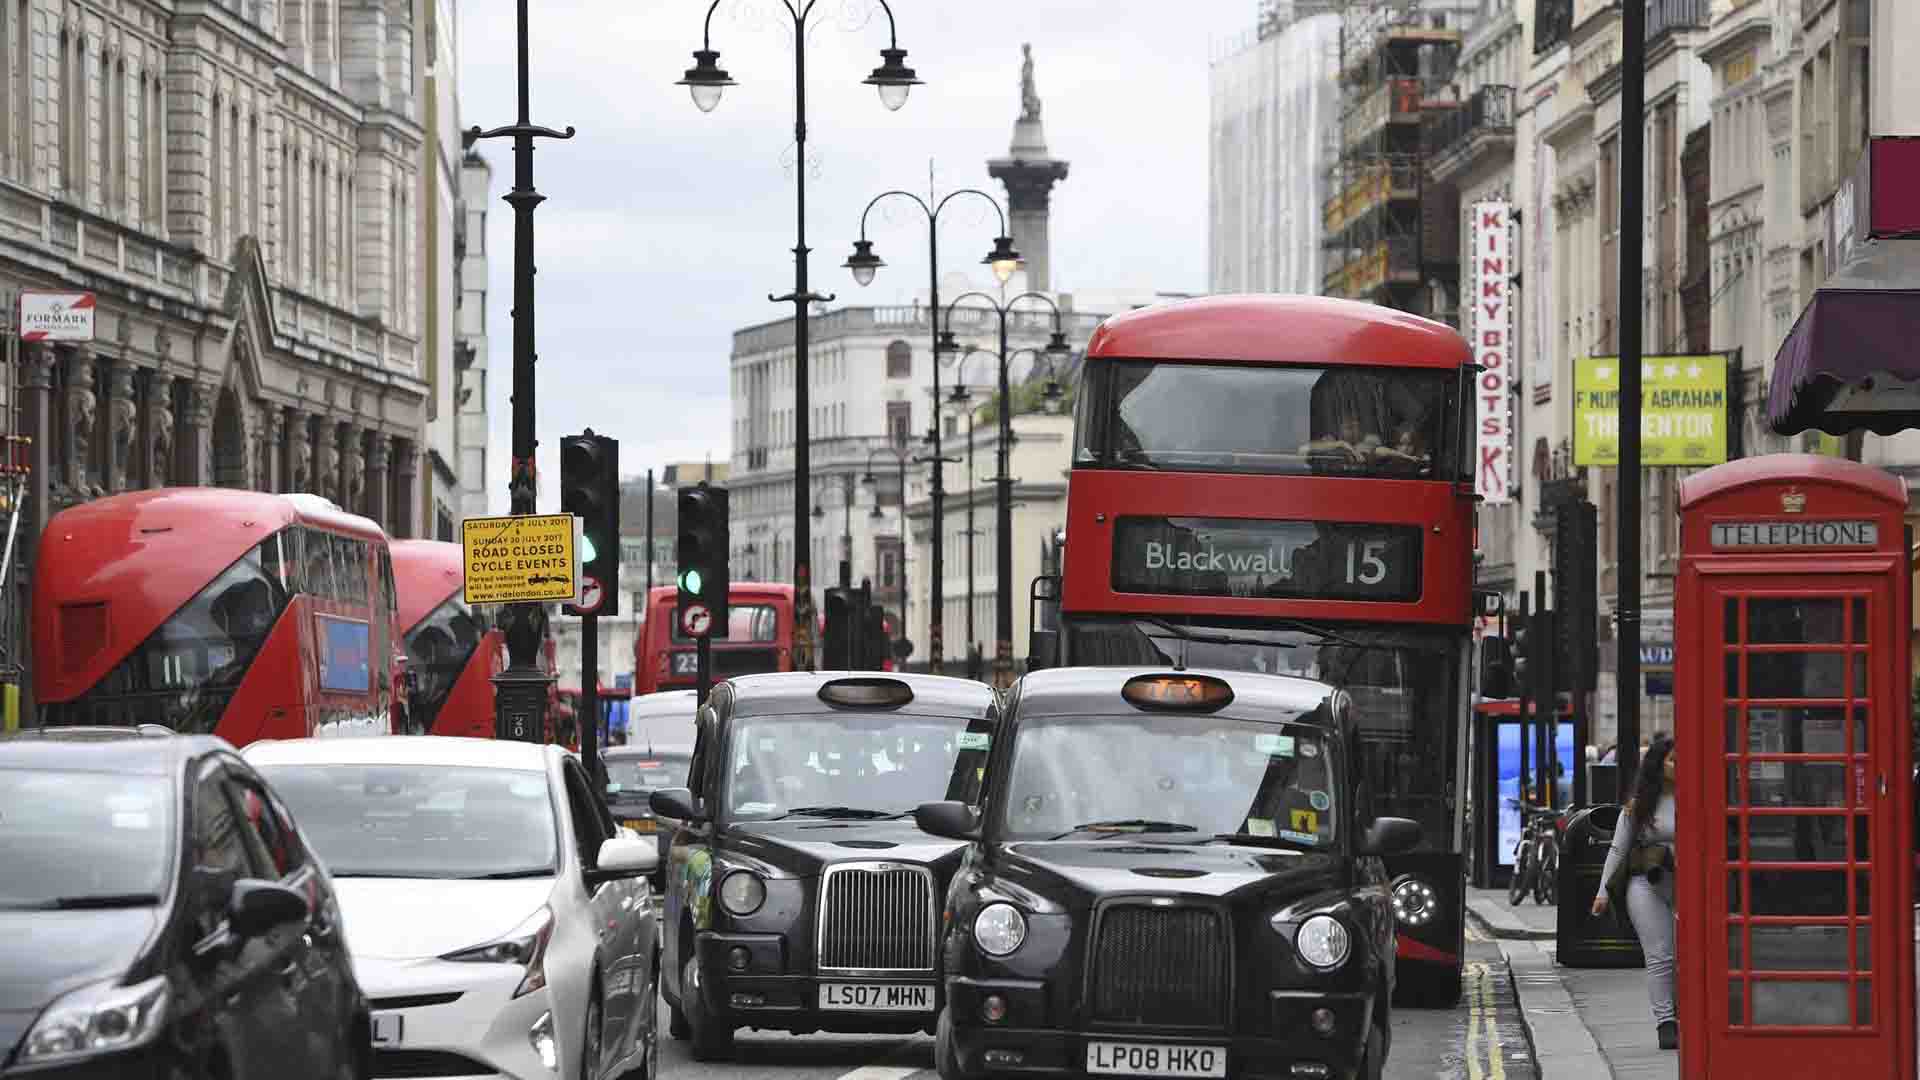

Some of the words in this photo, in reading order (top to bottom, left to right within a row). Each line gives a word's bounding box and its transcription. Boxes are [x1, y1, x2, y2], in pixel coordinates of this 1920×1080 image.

[1482, 211, 1503, 319] KINKY
[1482, 330, 1502, 436] BOOTS
[1577, 391, 1585, 408] F
[1651, 389, 1723, 408] ABRAHAM
[467, 521, 512, 530] SATURDAY
[528, 519, 547, 528] JULY
[549, 518, 568, 526] 2017
[1716, 523, 1873, 545] TELEPHONE
[472, 536, 508, 546] SUNDAY
[543, 534, 562, 542] 2017
[472, 546, 509, 559] ROAD
[512, 544, 565, 556] CLOSED
[471, 560, 512, 573] CYCLE
[517, 558, 568, 570] EVENTS
[1146, 542, 1291, 577] Blackwall
[1346, 543, 1387, 584] 15
[827, 987, 881, 1005] LS07
[887, 987, 927, 1007] MHN
[1095, 1045, 1160, 1070] LP08
